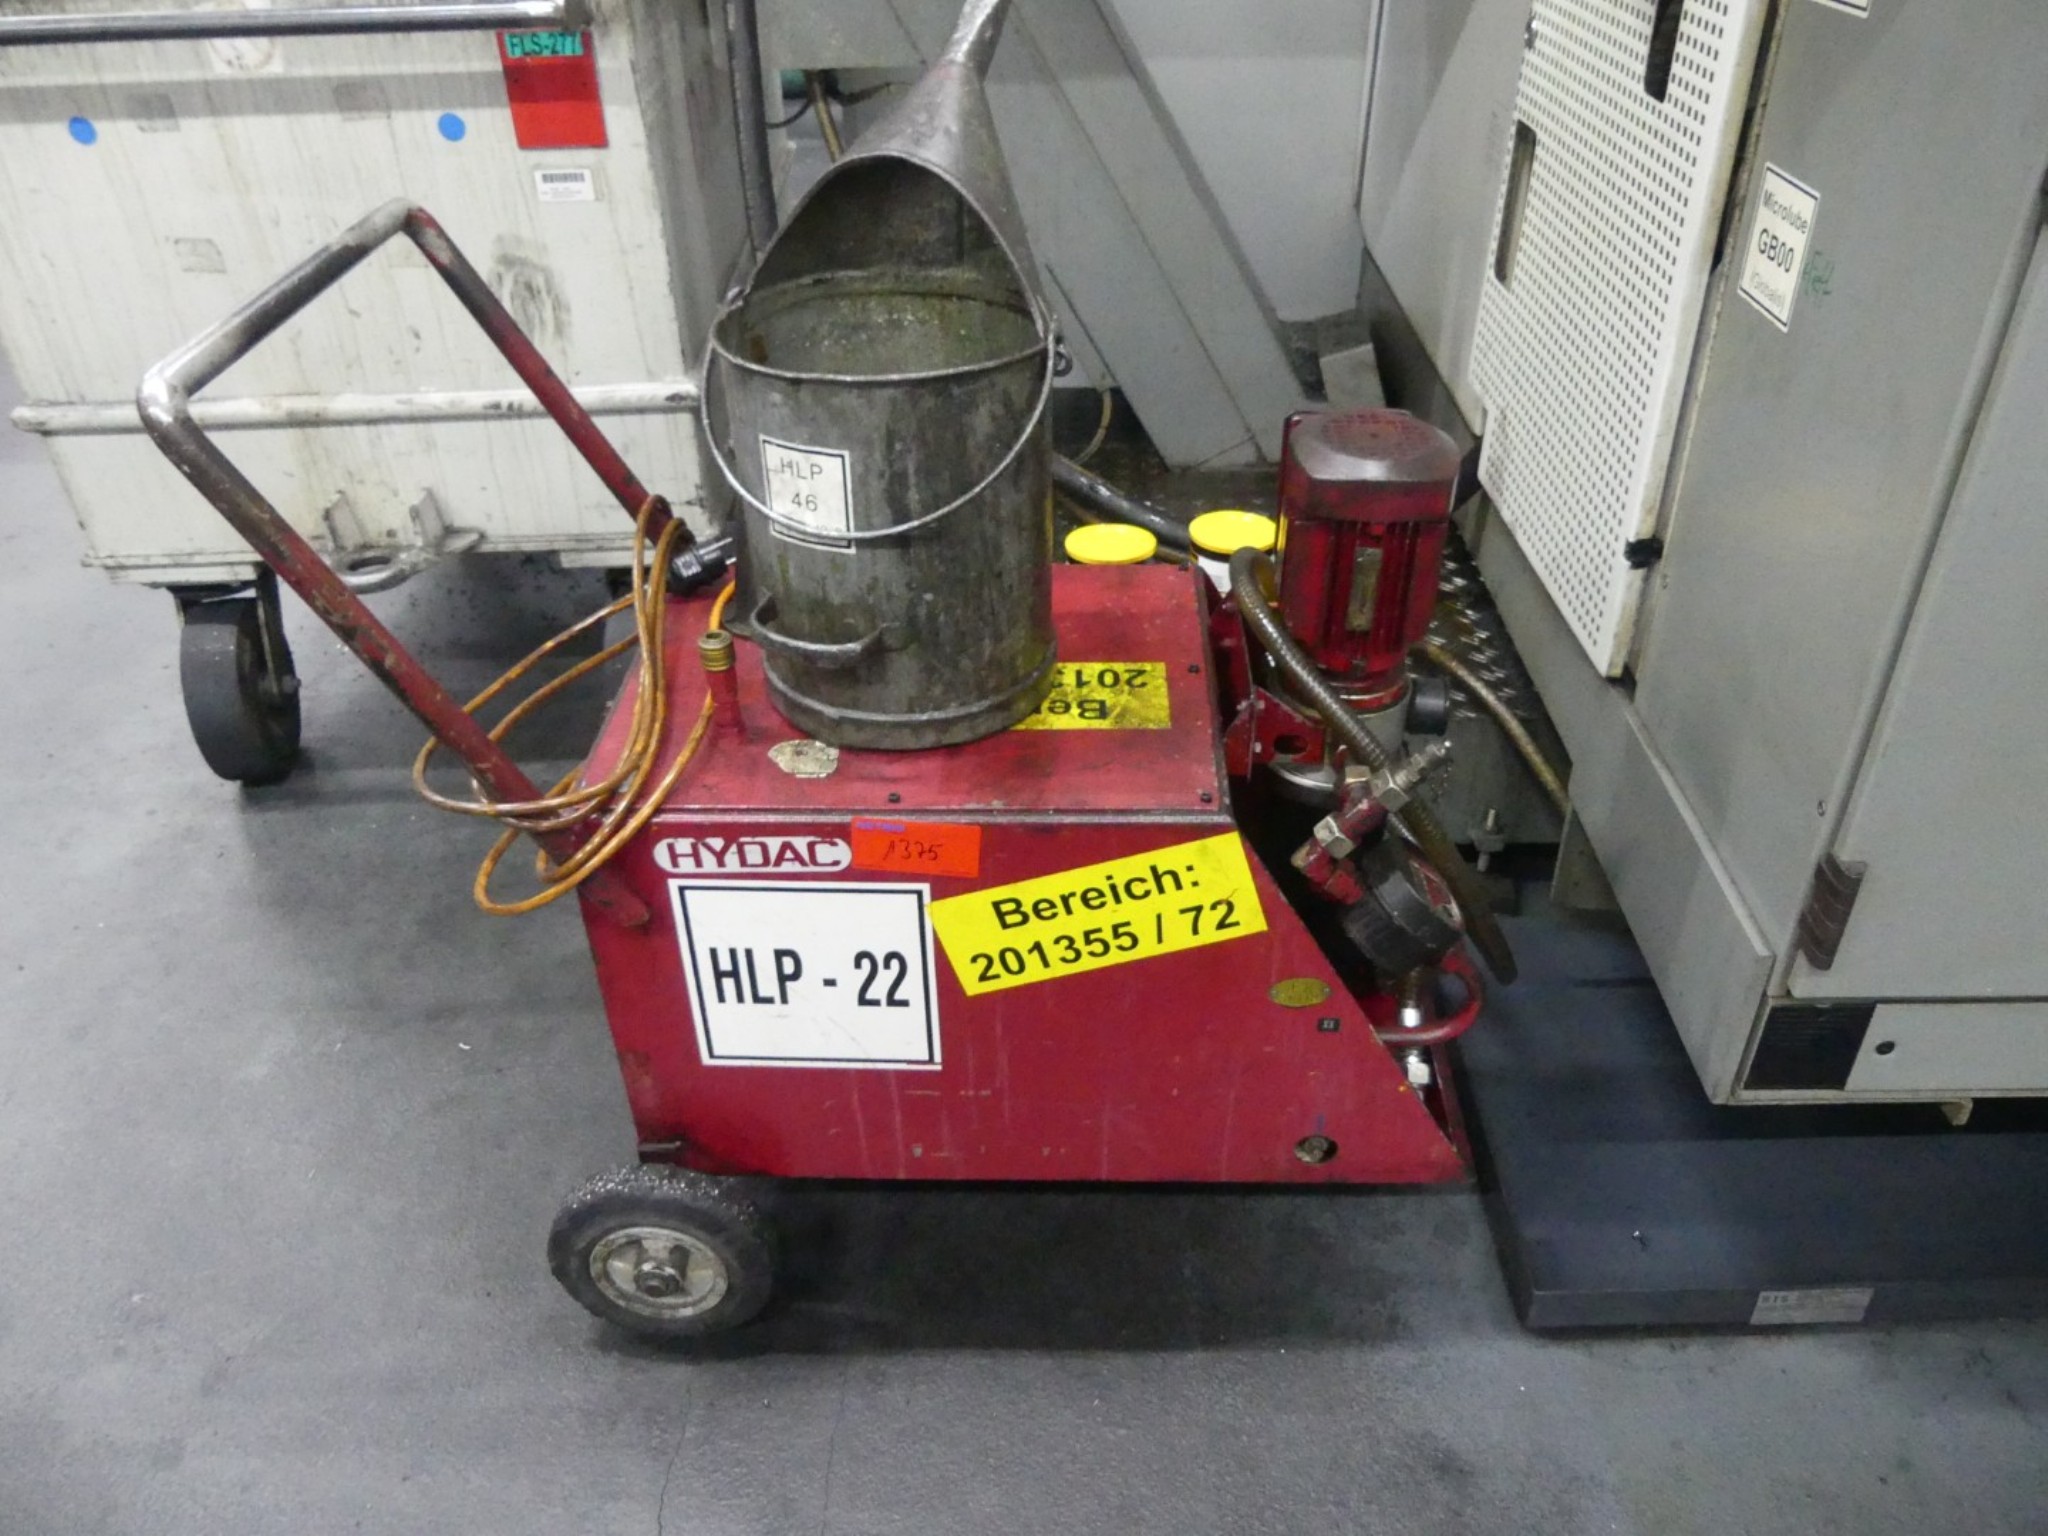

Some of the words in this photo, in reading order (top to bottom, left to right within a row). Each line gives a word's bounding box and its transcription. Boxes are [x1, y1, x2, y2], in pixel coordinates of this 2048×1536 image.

[1763, 189, 1809, 234] Microlube
[780, 457, 823, 480] HLP
[791, 492, 818, 512] 46
[666, 839, 842, 868] HYDAC
[991, 864, 1200, 930] Bereich:
[970, 921, 1140, 983] 201355
[1179, 899, 1241, 937] 72
[709, 947, 803, 1005] HLP
[822, 978, 838, 988] -
[854, 950, 910, 1008] 22
